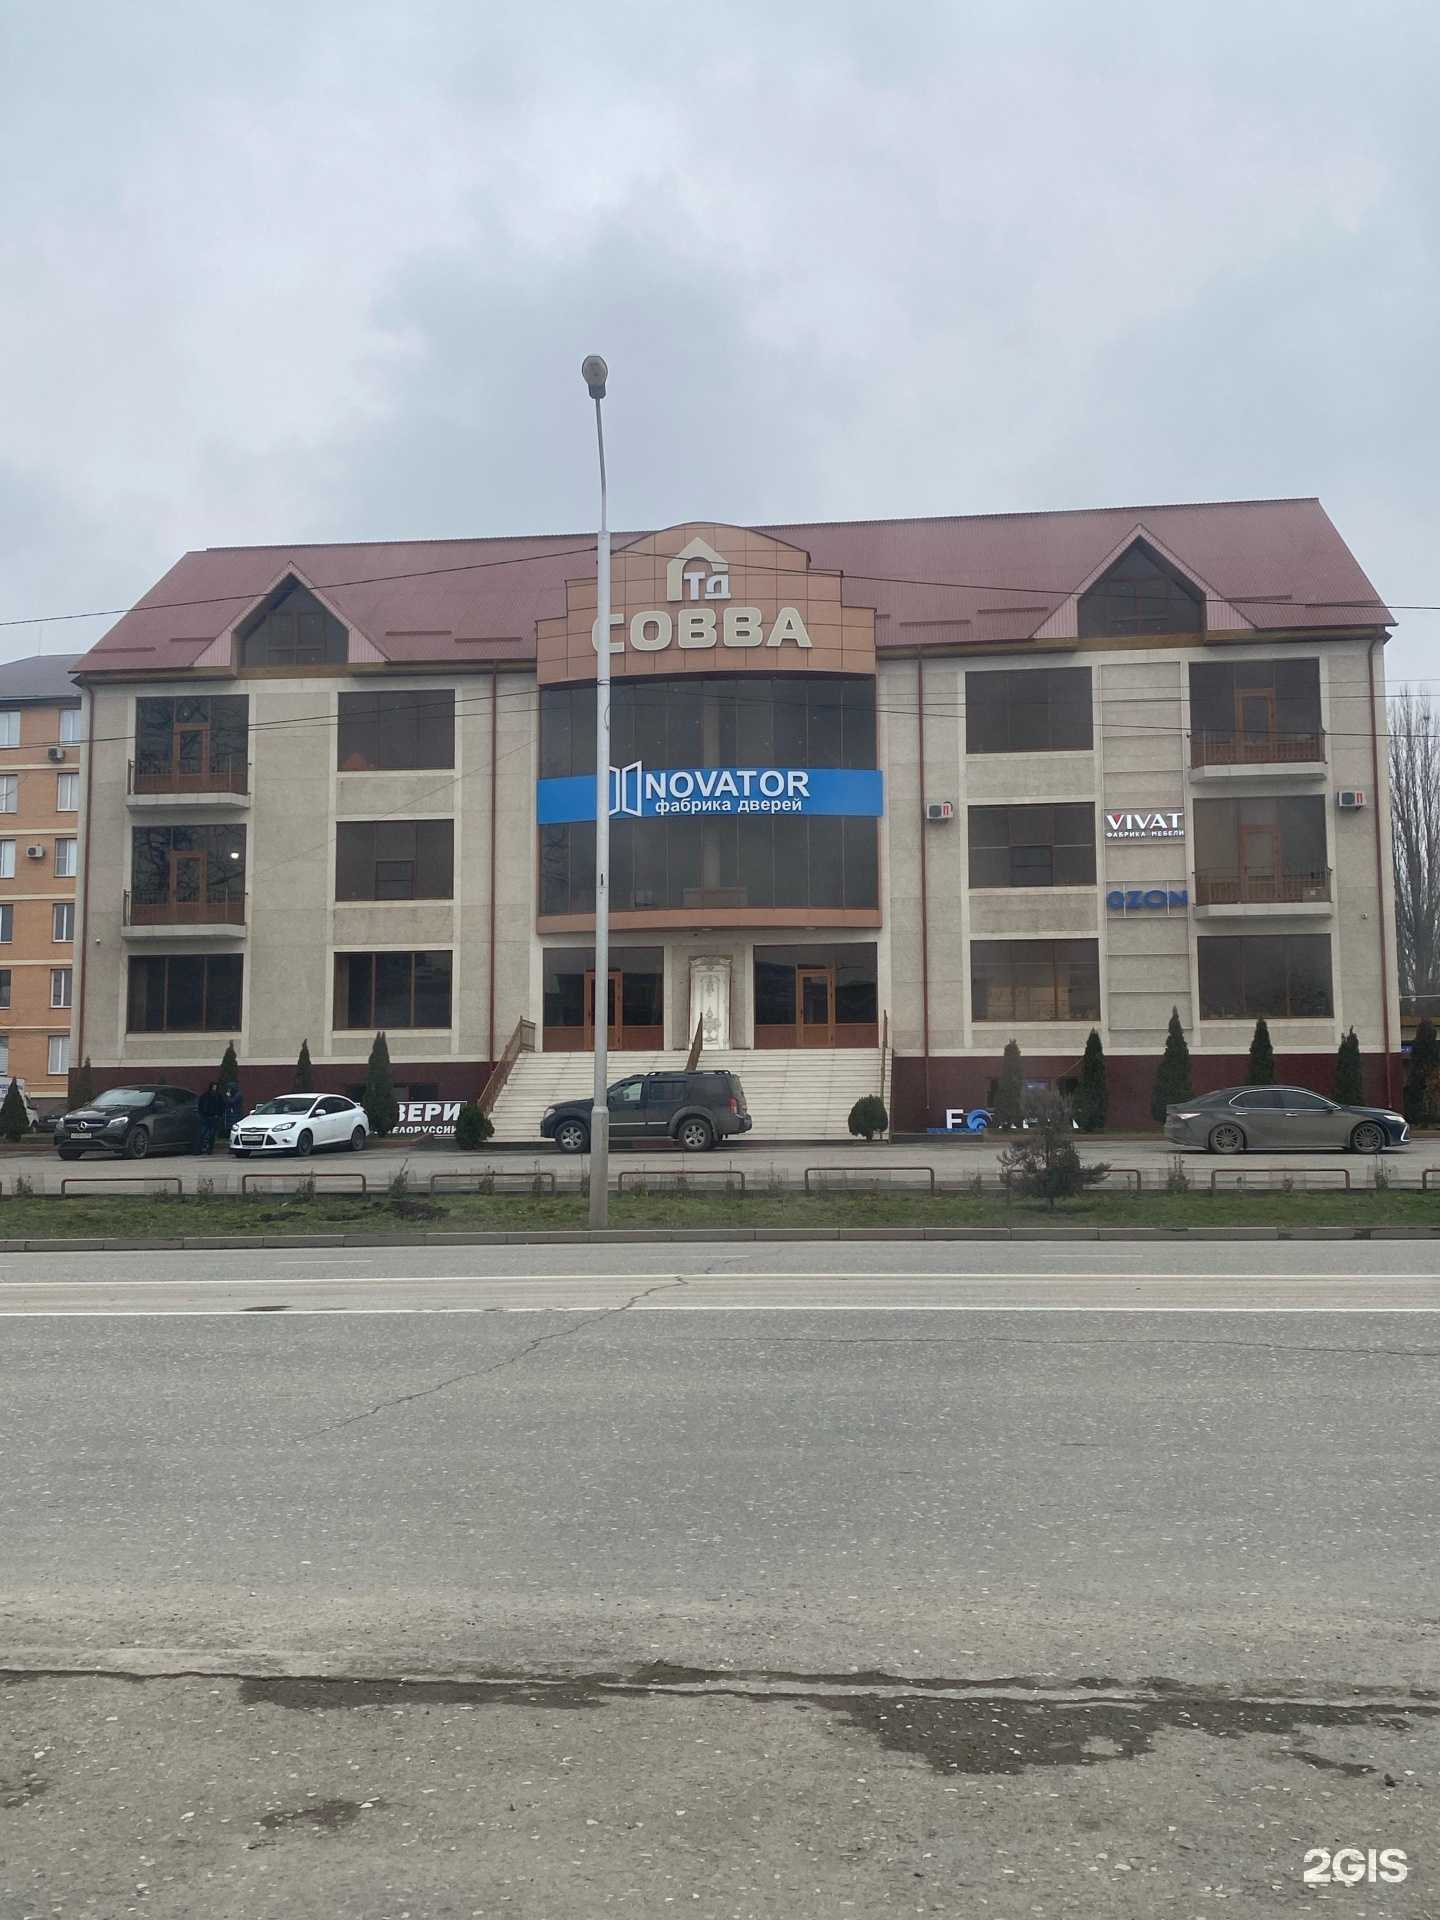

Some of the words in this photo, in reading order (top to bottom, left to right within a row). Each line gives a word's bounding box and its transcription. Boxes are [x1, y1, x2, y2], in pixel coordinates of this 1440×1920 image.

[591, 606, 813, 653] СОВВА
[645, 770, 811, 799] NOVATOR
[655, 799, 731, 815] фабрика
[738, 798, 802, 814] дверей
[1106, 812, 1183, 830] VIVAT
[1105, 830, 1146, 838] ФАБРИКА
[1106, 889, 1188, 910] OZON
[398, 1103, 461, 1122] ВЕРИ
[388, 1125, 457, 1134] ЕЛОРУССИИ
